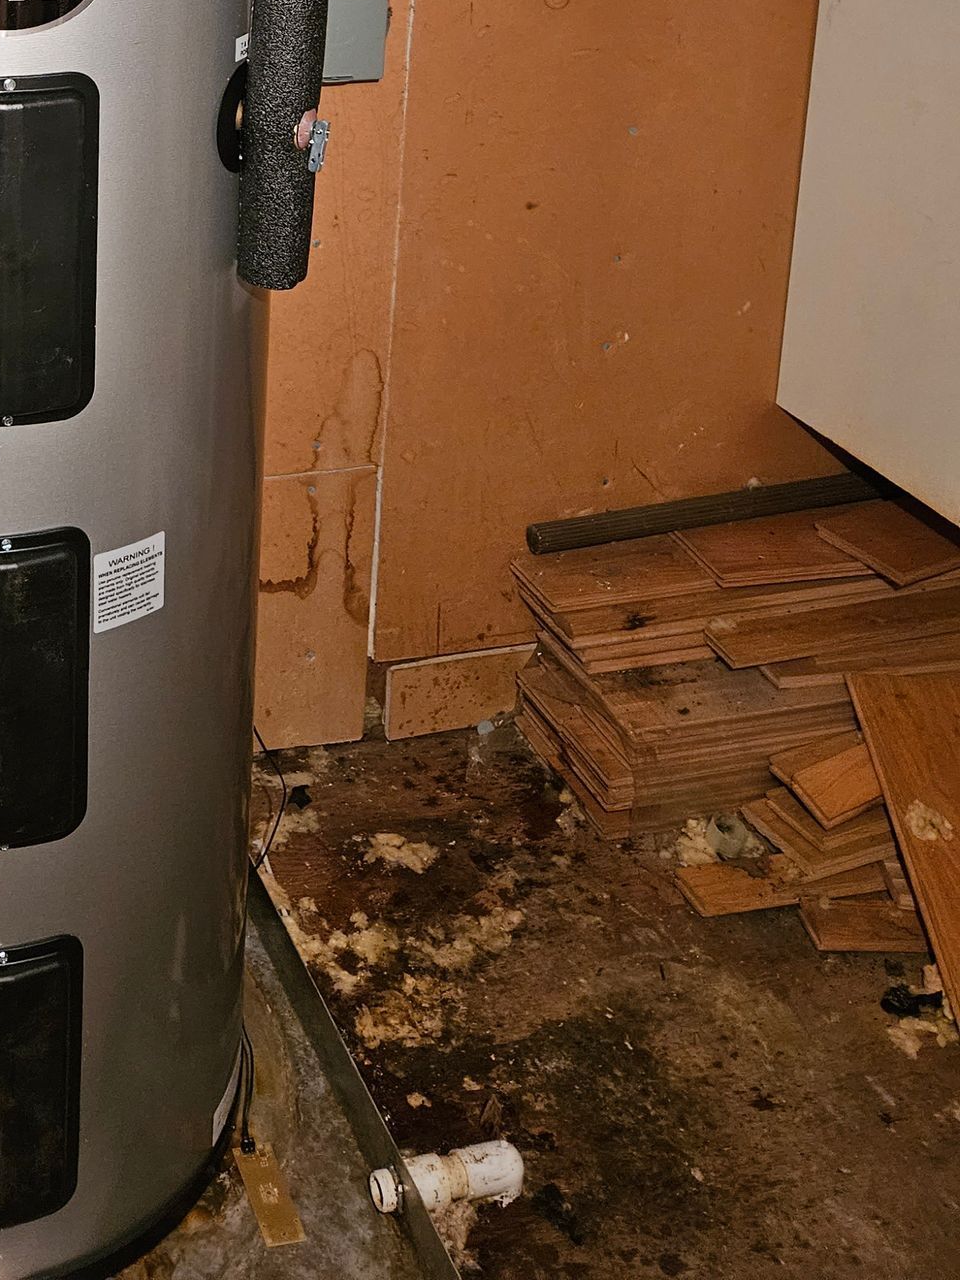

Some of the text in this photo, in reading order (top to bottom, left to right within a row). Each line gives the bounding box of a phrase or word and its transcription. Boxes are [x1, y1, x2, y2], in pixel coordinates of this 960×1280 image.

[98, 552, 162, 578] WHEN REPLACING ELEMENTS
[108, 548, 150, 567] WARNING
